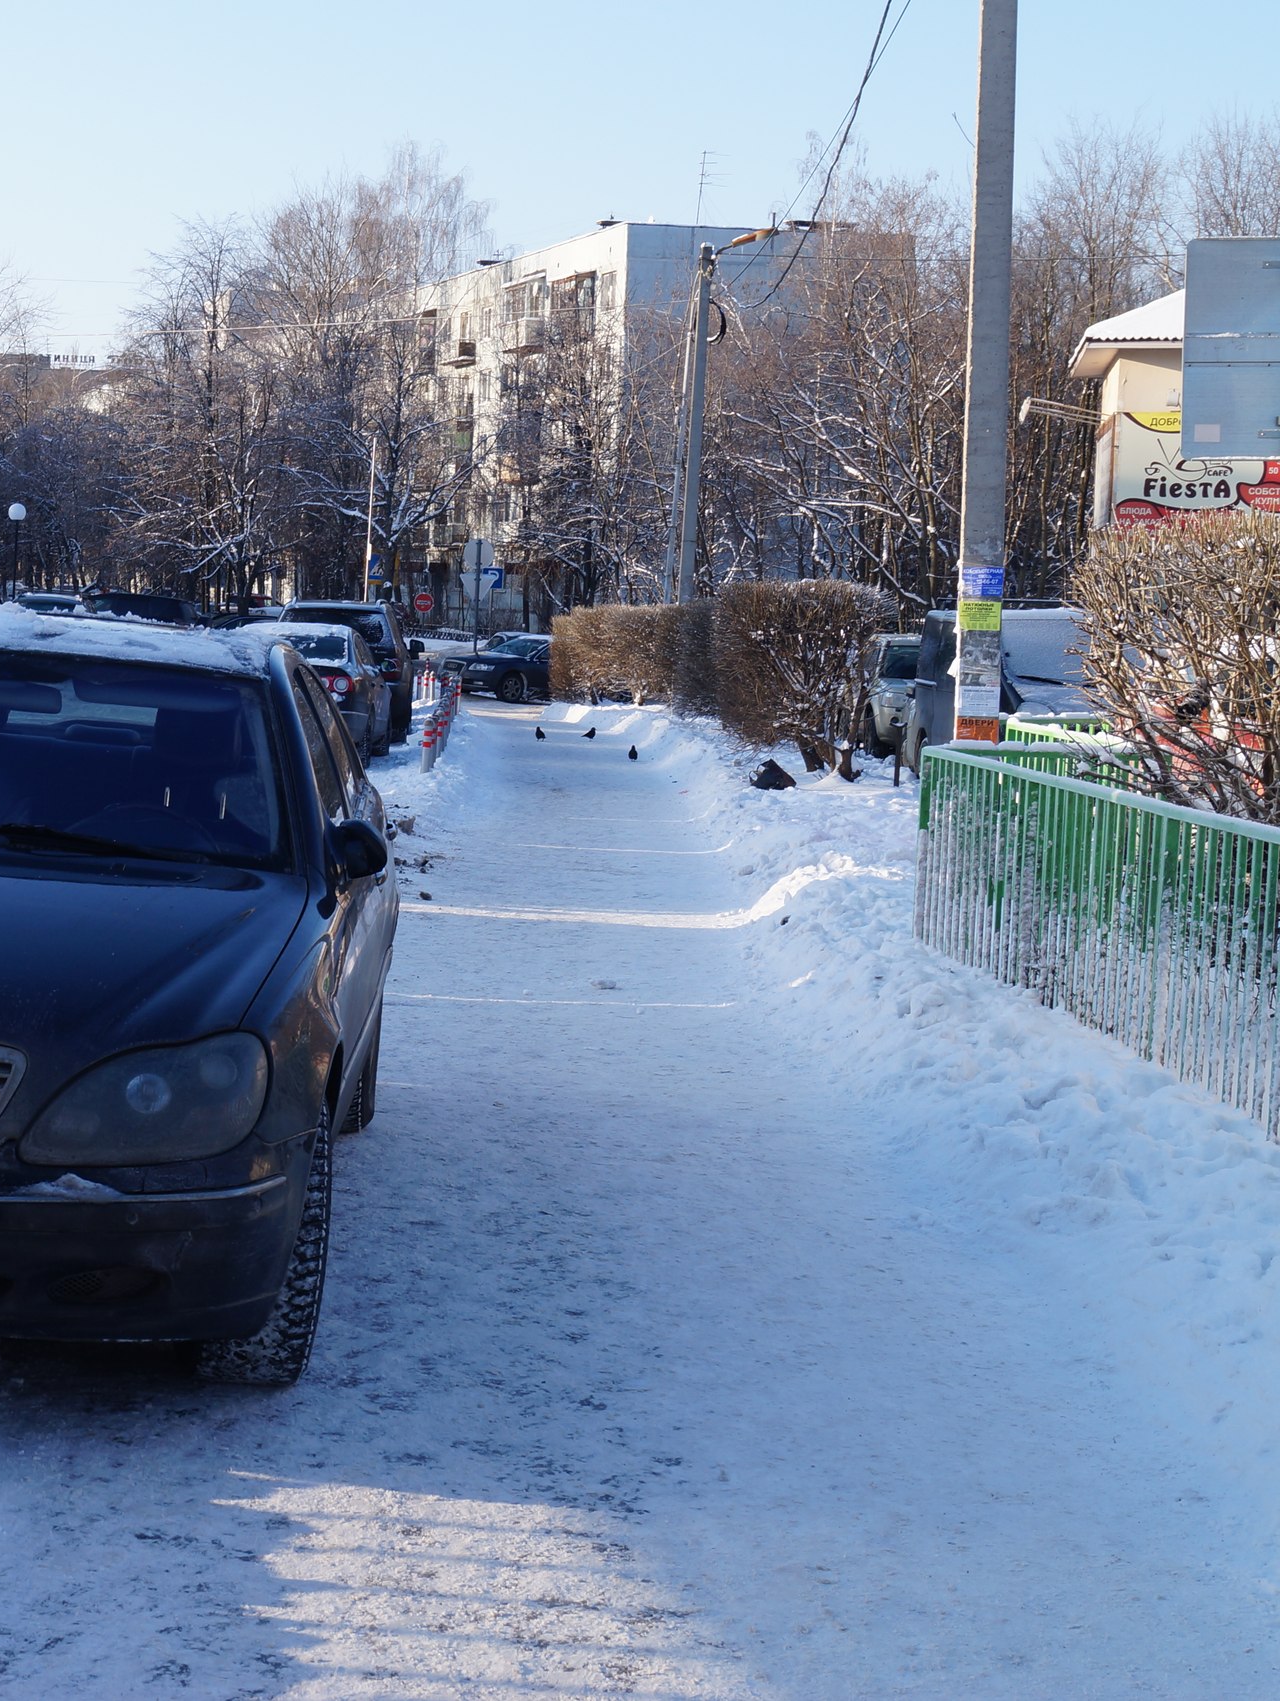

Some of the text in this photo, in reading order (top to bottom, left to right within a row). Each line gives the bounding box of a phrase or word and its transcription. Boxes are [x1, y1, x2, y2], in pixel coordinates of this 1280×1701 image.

[1207, 469, 1229, 477] CAFE
[1119, 507, 1152, 517] БЛЮДА
[960, 718, 995, 727] ДВЕРИ
